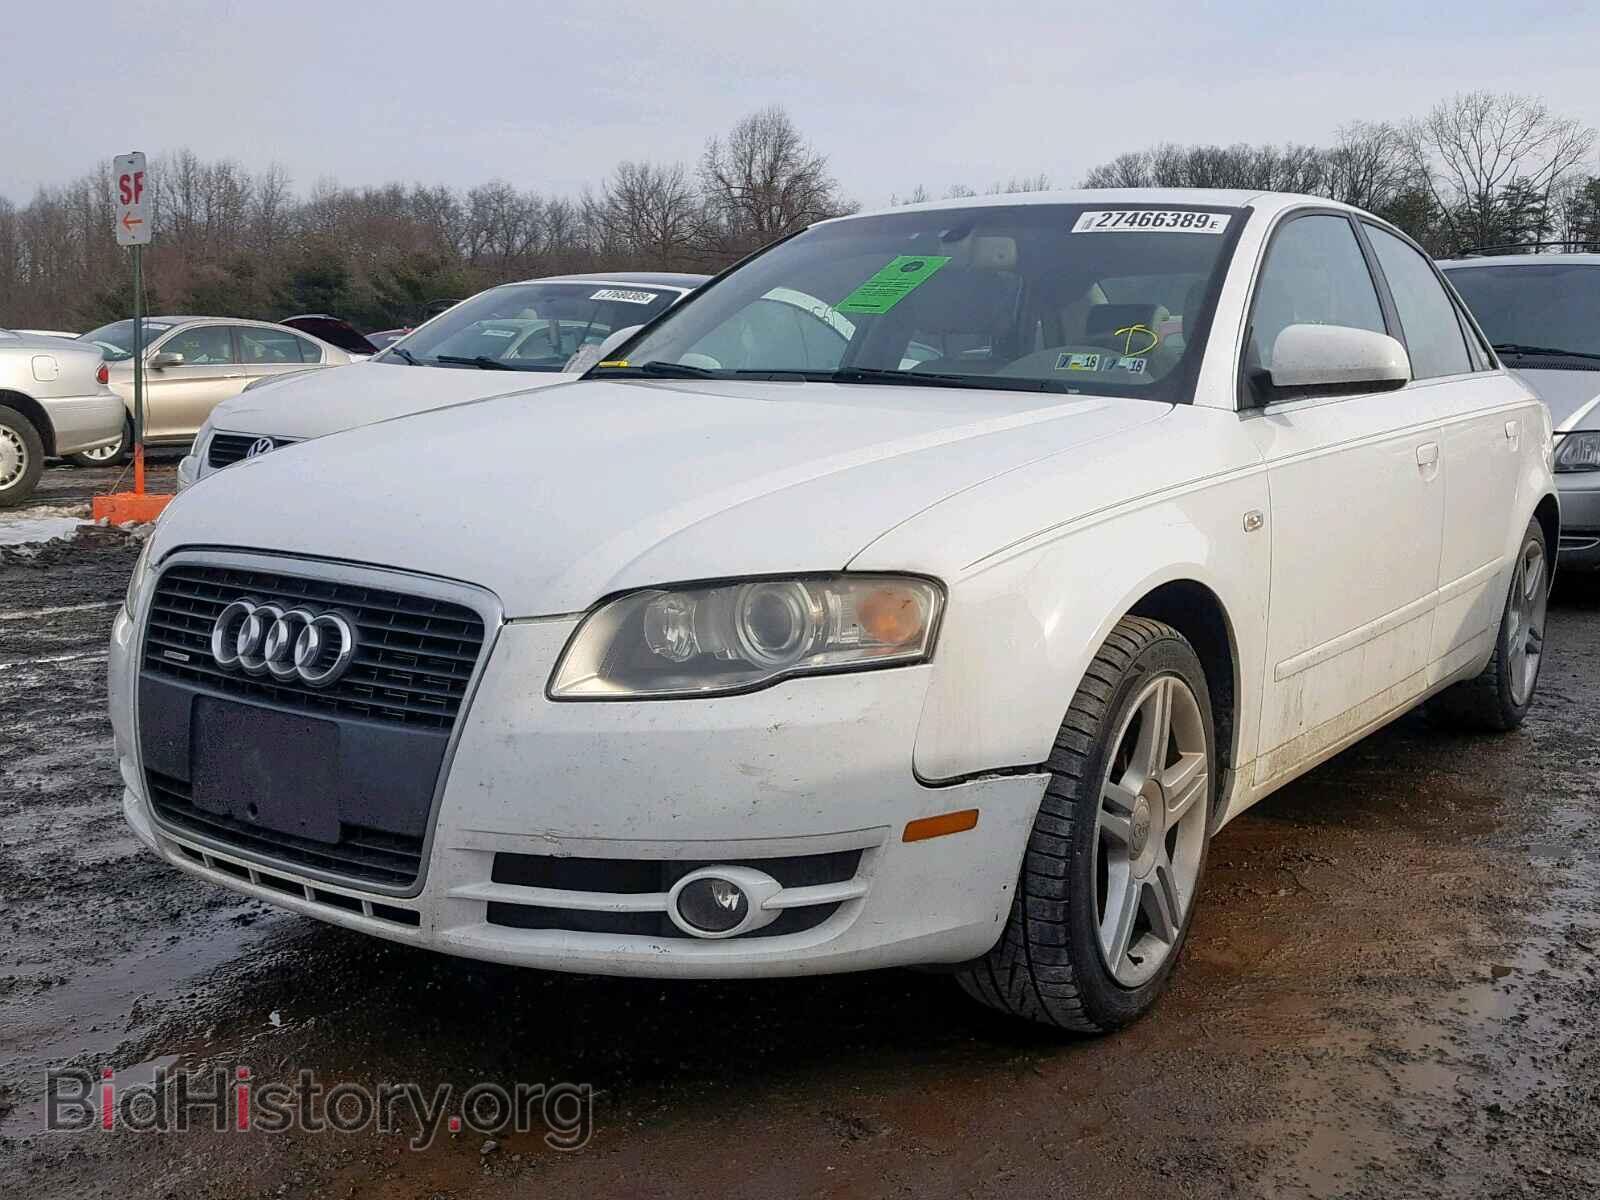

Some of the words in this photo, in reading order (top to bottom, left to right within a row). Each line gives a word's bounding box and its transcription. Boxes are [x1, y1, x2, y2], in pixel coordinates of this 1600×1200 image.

[119, 171, 144, 205] SF
[1096, 212, 1210, 229] 27466389
[1084, 355, 1098, 368] 18
[1129, 360, 1144, 372] 18
